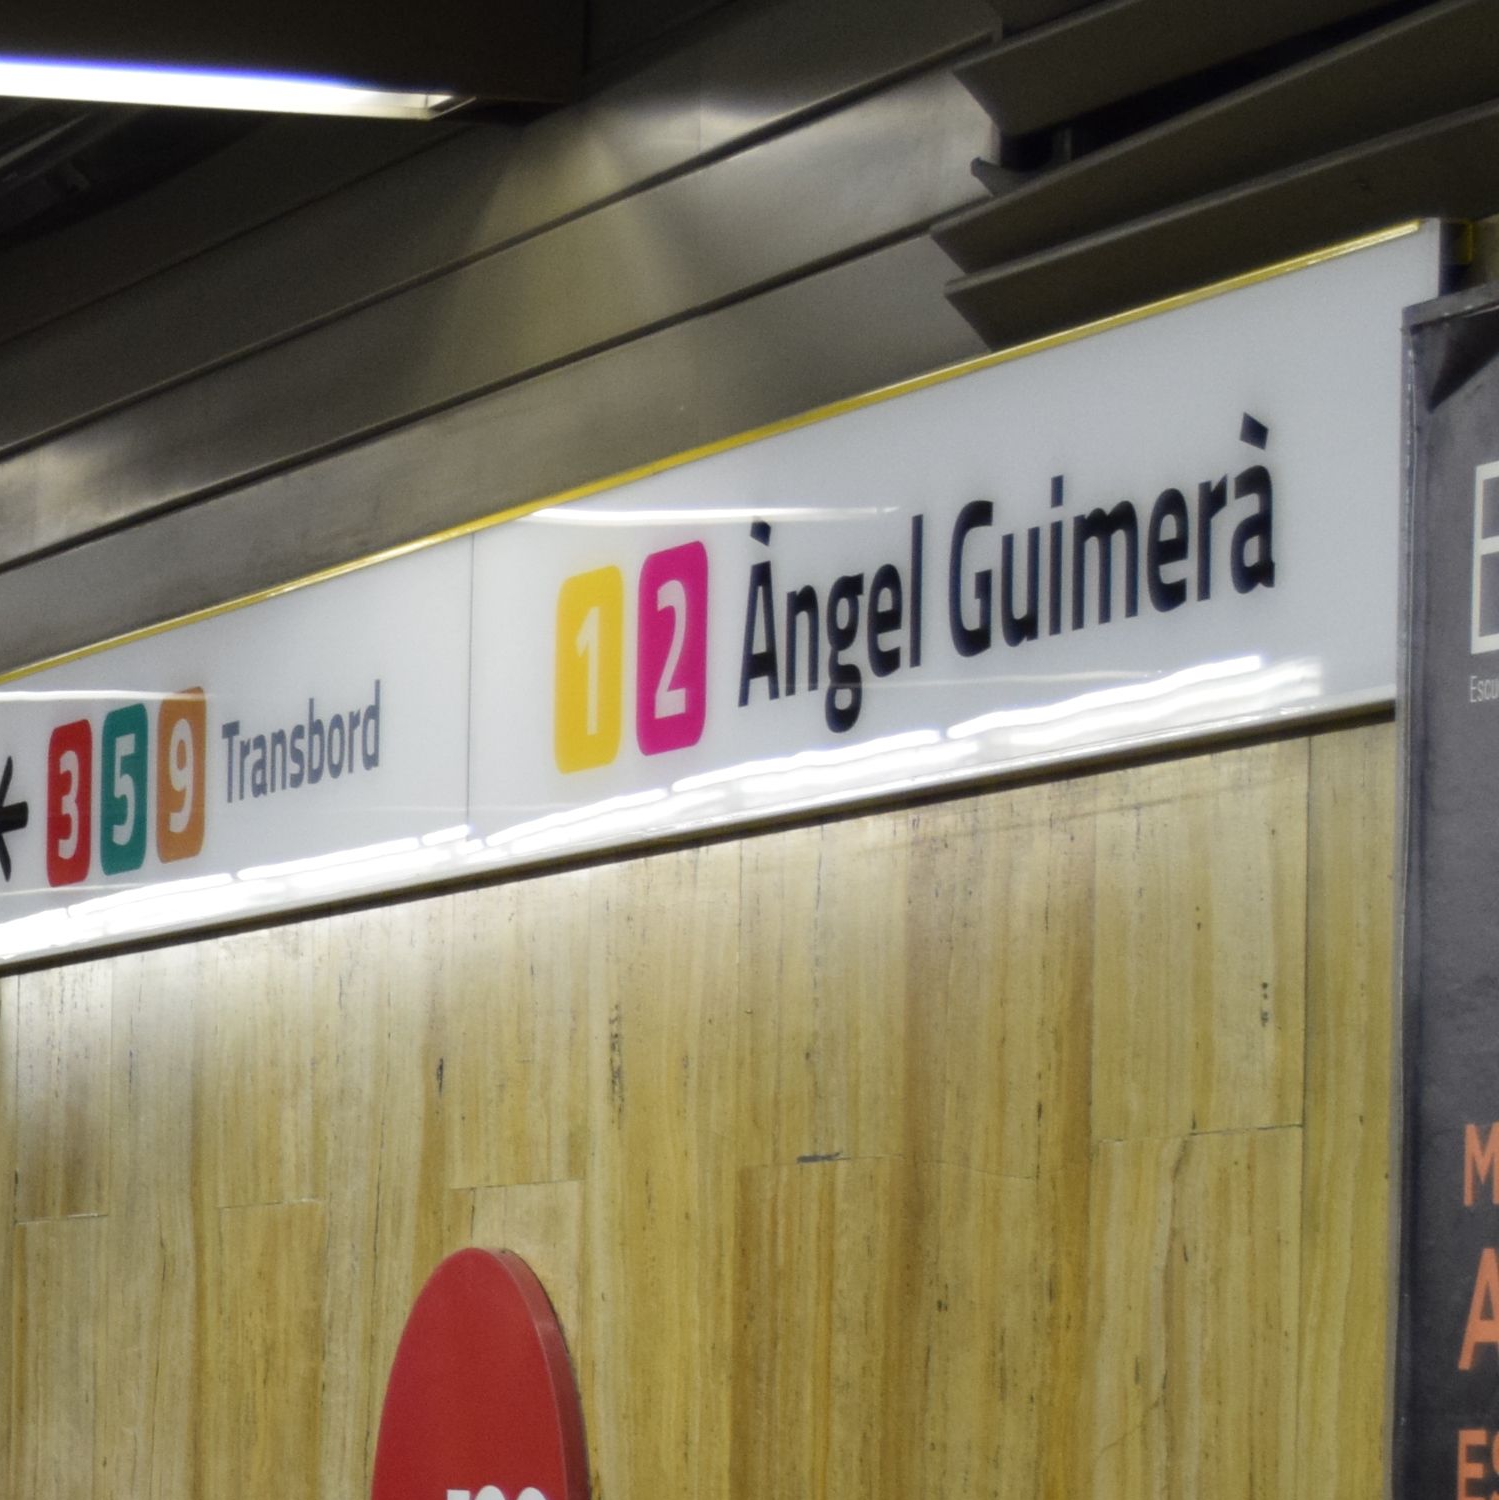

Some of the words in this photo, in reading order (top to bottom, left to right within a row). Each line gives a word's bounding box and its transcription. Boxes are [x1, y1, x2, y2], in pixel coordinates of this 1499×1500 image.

[574, 606, 599, 736] 1
[654, 578, 687, 720] 2
[737, 514, 924, 733] Àngel
[949, 411, 1277, 658] Guimerà
[57, 750, 79, 859] 3
[112, 734, 136, 846] 5
[169, 718, 194, 833] 9
[222, 679, 381, 803] Transbord
